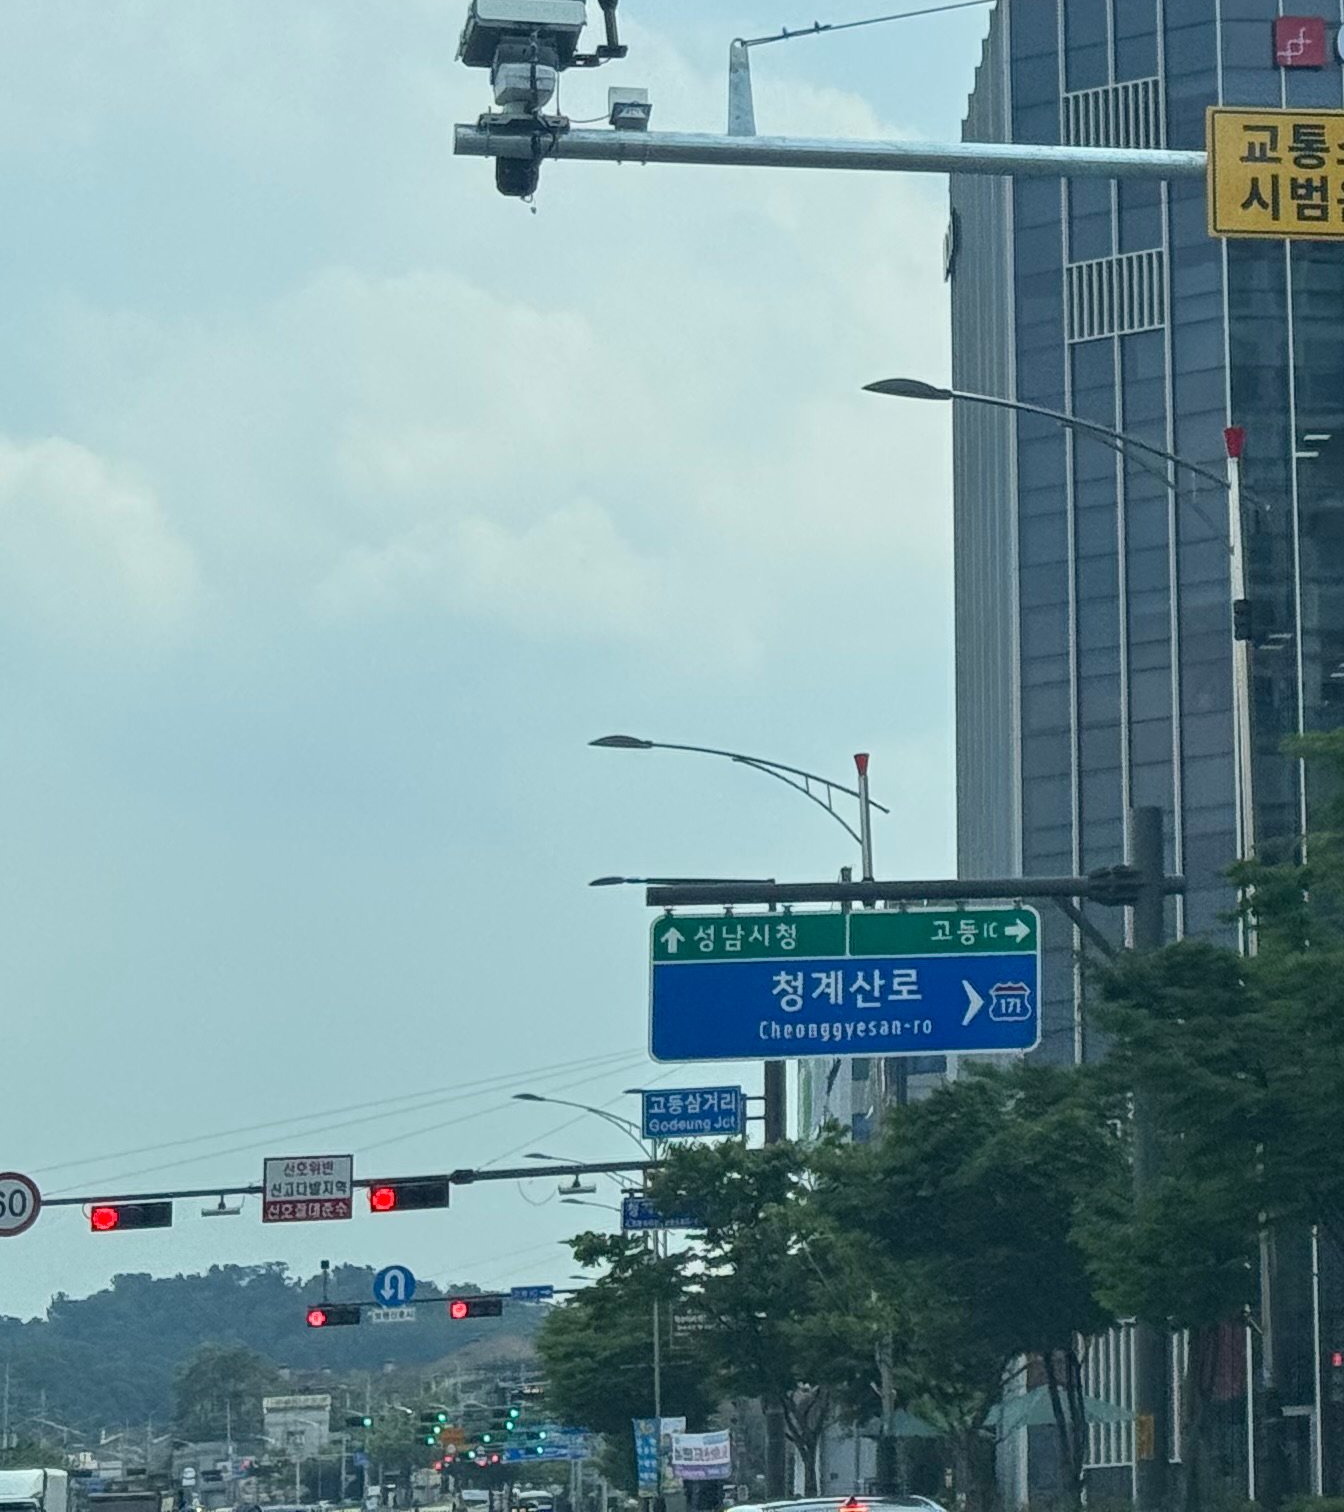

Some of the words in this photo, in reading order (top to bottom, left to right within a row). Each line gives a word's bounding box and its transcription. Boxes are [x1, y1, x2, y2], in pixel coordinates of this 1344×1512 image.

[693, 922, 798, 952] 성남시청
[771, 968, 923, 1013] 청계산로
[1000, 997, 1021, 1014] 171
[758, 1017, 933, 1042] Cheonggyesan-ro
[649, 1091, 737, 1115] 고등삼거리
[649, 1119, 712, 1133] Godeung
[714, 1115, 736, 1129] Jct
[284, 1160, 335, 1177] 신호위반
